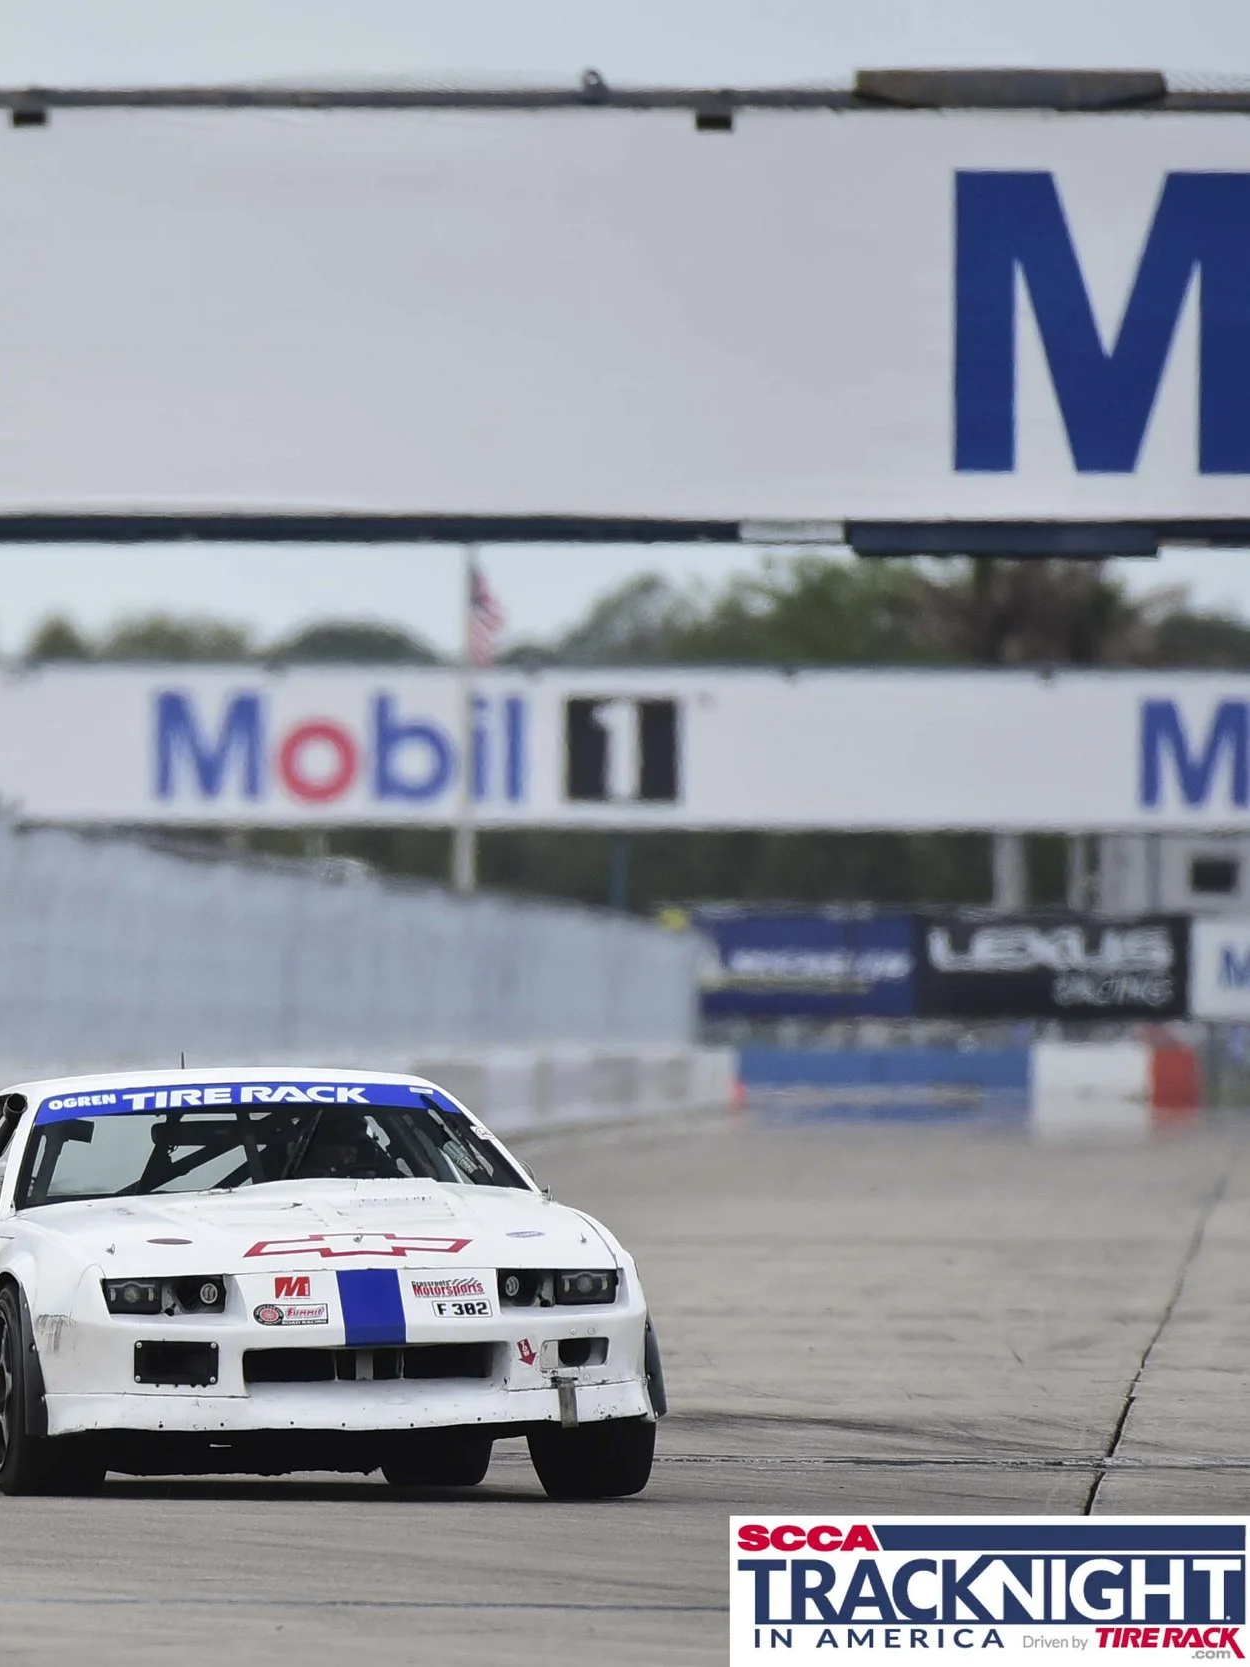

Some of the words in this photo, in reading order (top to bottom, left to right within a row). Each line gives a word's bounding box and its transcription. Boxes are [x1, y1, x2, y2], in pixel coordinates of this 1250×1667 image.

[155, 690, 522, 804] Mobil
[592, 699, 642, 801] 1
[48, 1093, 116, 1111] OGREN
[123, 1087, 232, 1110] TIRE
[239, 1086, 371, 1104] RACK
[413, 1282, 484, 1296] Motorsports
[436, 1303, 447, 1315] F
